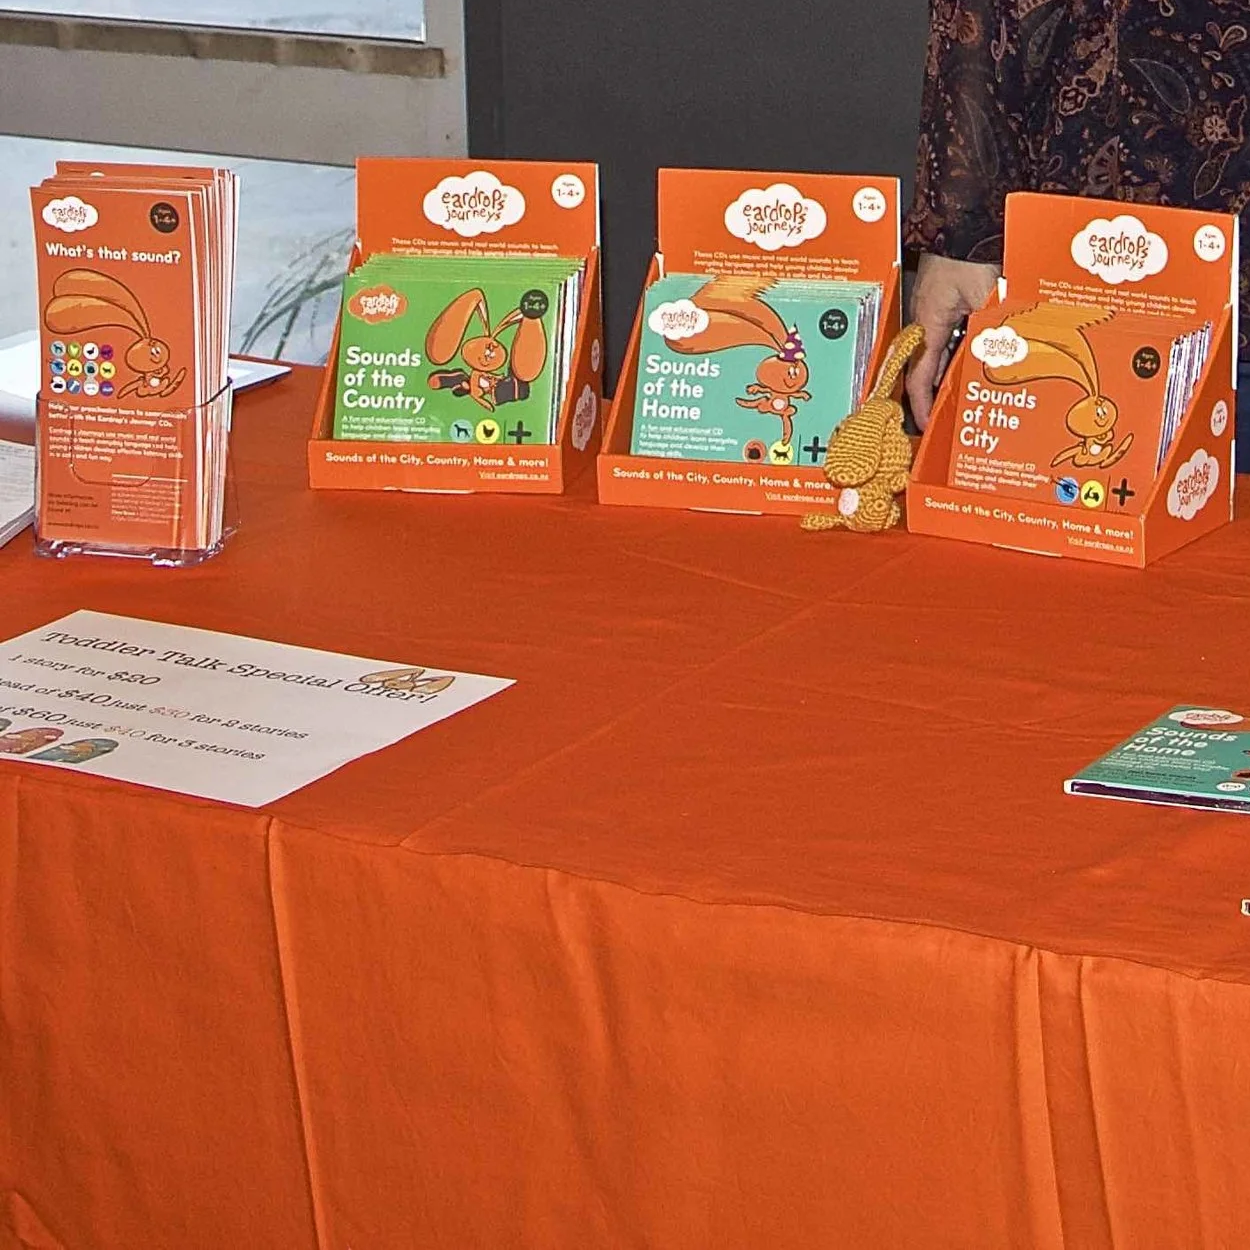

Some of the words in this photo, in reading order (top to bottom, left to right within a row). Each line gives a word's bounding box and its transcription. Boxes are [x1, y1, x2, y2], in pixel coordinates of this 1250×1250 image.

[441, 186, 505, 211] eardrops
[556, 188, 580, 197] 1-4+
[445, 205, 501, 223] journeys
[743, 198, 807, 224] eardrops
[746, 219, 802, 237] journeys
[45, 242, 94, 258] What's
[97, 246, 127, 261] that
[131, 250, 181, 264] sound?
[1089, 231, 1148, 258] eardrops
[1091, 249, 1144, 270] journeys
[345, 345, 421, 367] Sounds
[645, 354, 720, 377] Sounds
[344, 367, 366, 387] of
[371, 369, 405, 388] the
[643, 377, 665, 395] of
[670, 378, 703, 398] the
[343, 388, 425, 414] Country
[966, 381, 1037, 409] Sounds
[642, 398, 700, 420] Home
[963, 405, 984, 424] of
[988, 408, 1020, 430] the
[960, 426, 999, 454] City
[326, 452, 363, 463] Sounds
[366, 454, 377, 464] of
[380, 454, 397, 464] the
[400, 454, 424, 466] City,
[427, 455, 471, 467] Country,
[474, 457, 504, 466] Home
[507, 457, 515, 466] &
[519, 458, 549, 467] more!
[613, 467, 650, 479] Sounds
[653, 471, 664, 480] of
[667, 472, 683, 481] the
[686, 473, 709, 484] City,
[760, 477, 789, 487] Home
[793, 478, 800, 488] &
[925, 497, 959, 512] Sounds
[962, 505, 972, 514] of
[975, 506, 990, 517] the
[993, 509, 1014, 522] City,
[1018, 514, 1058, 529] Country,
[1063, 520, 1090, 532] Home
[1094, 524, 1101, 534] &
[1106, 528, 1133, 539] more!
[23, 656, 76, 671] story
[75, 666, 105, 677] for
[107, 670, 161, 685] $20
[41, 631, 155, 657] Toddler
[157, 650, 227, 670] Talk
[227, 663, 343, 688] Special
[344, 682, 438, 704] Offer!
[0, 678, 36, 691] ead
[34, 687, 61, 695] of
[57, 688, 112, 703] $40
[103, 700, 147, 712] just
[149, 706, 190, 719] $30
[190, 713, 221, 724] for
[221, 719, 240, 728] 2
[238, 723, 309, 740] stories
[12, 707, 68, 722] $60
[57, 717, 103, 730] just
[104, 725, 146, 737] $40
[145, 733, 177, 745] for
[178, 740, 195, 748] 3
[194, 743, 266, 760] stories
[1134, 735, 1165, 744] of
[1168, 737, 1208, 748] the
[1146, 727, 1238, 742] Sounds
[1122, 742, 1196, 756] Home
